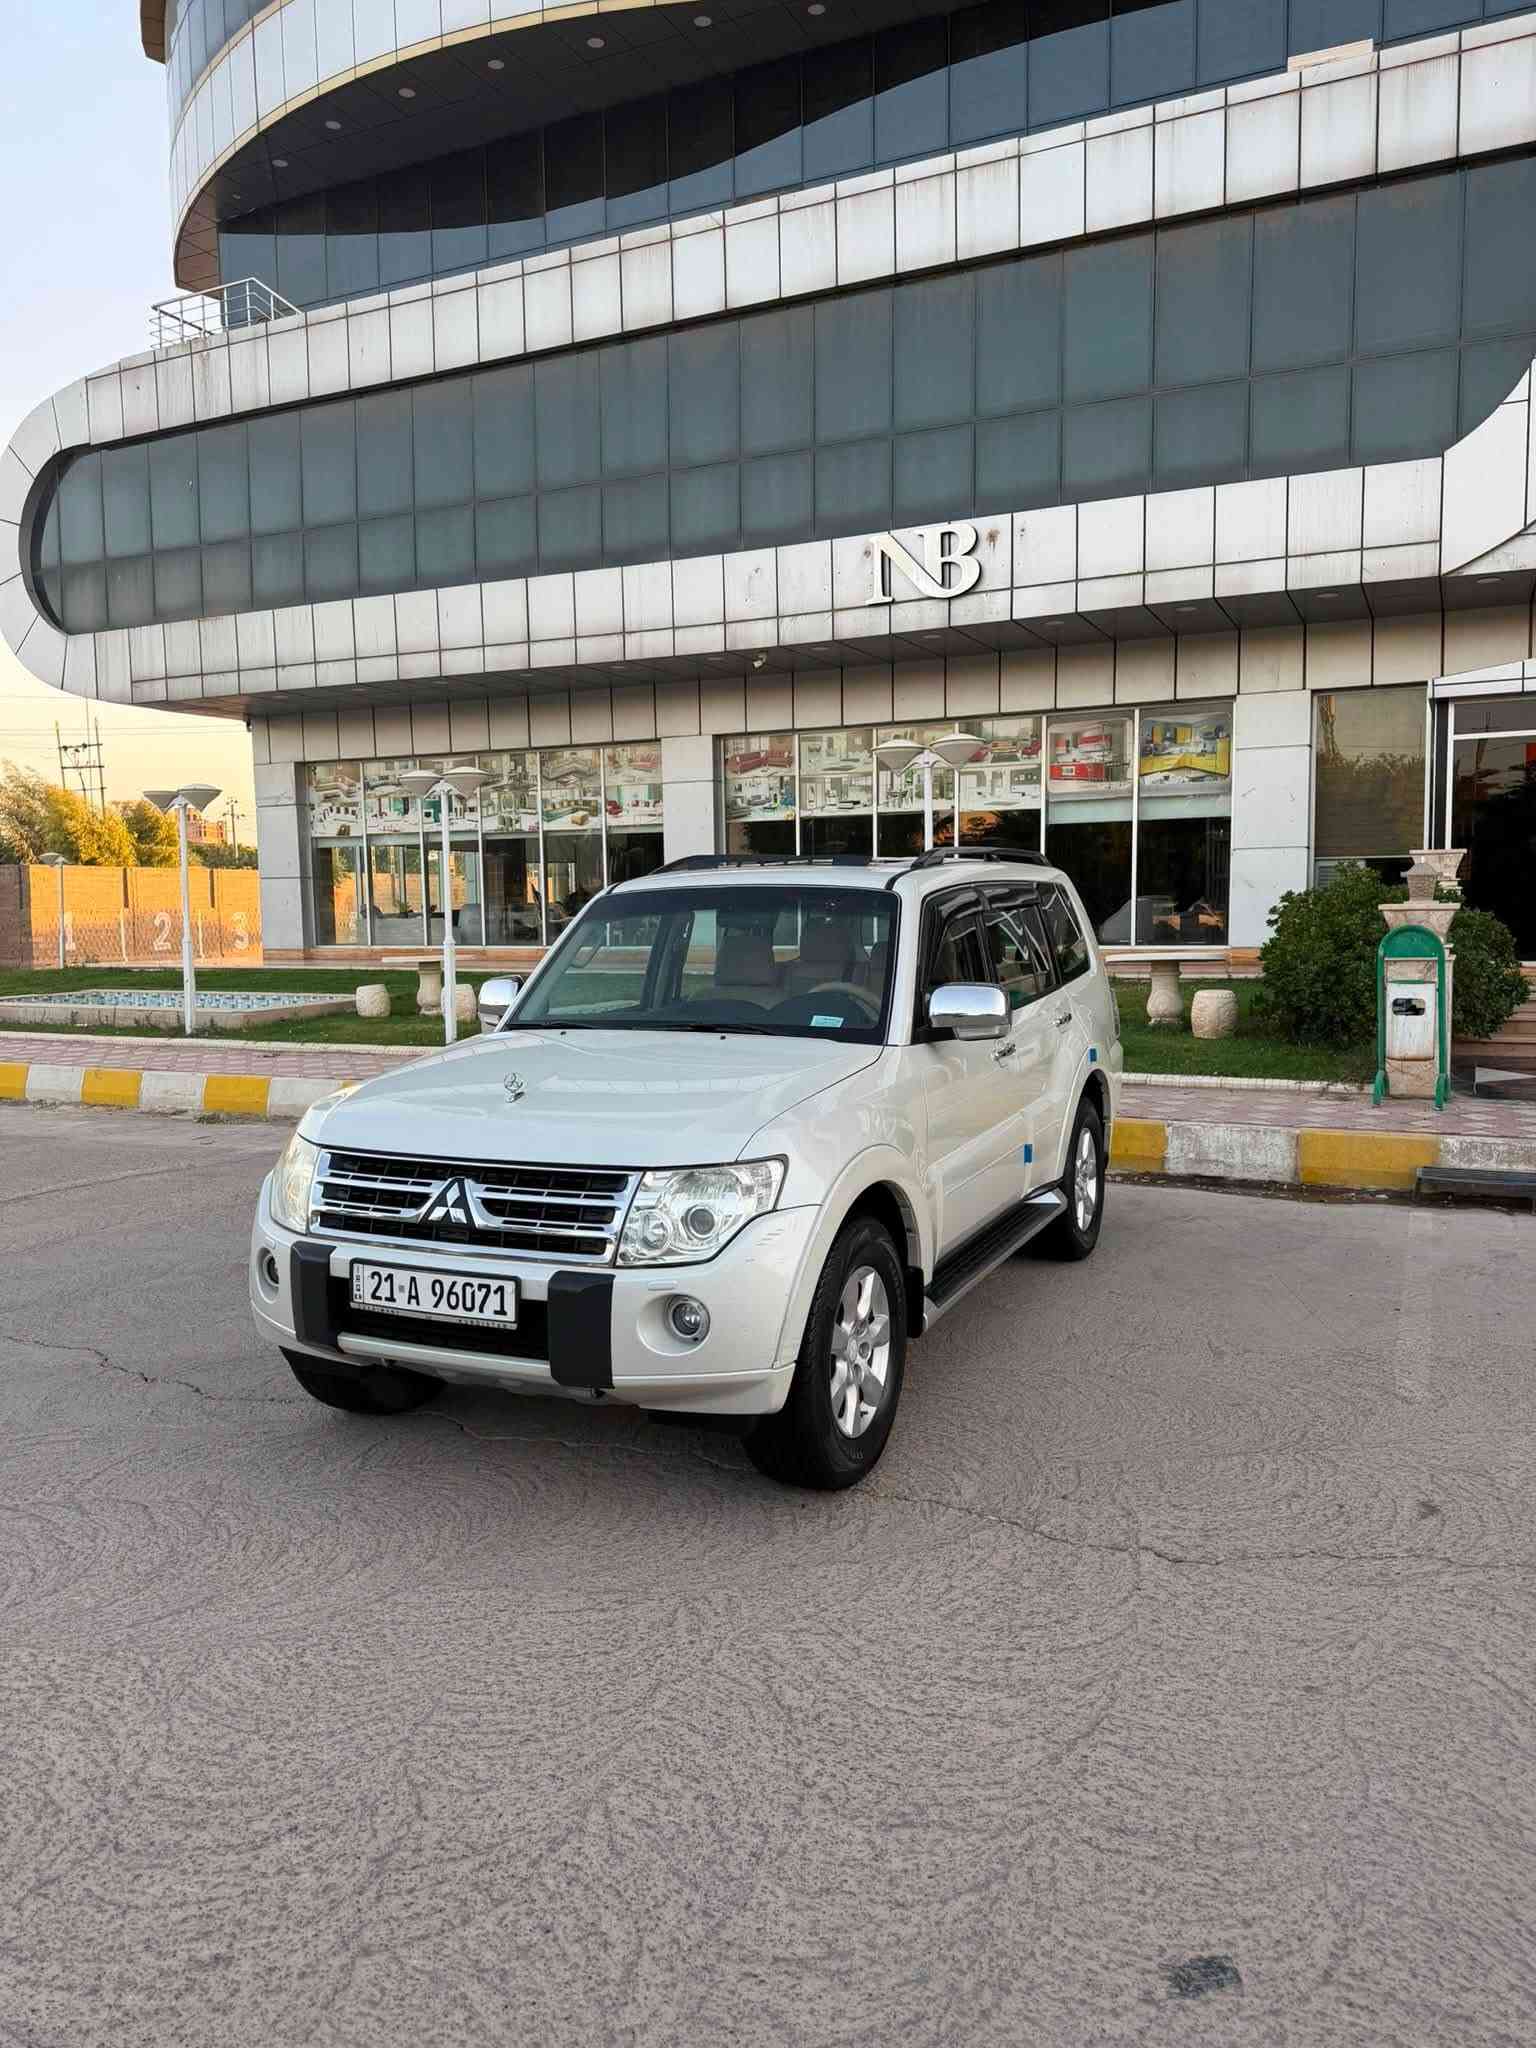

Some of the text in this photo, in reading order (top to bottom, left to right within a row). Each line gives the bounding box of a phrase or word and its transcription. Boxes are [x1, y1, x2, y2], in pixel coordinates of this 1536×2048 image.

[865, 523, 981, 606] NB
[153, 912, 172, 950] 2
[232, 911, 249, 950] 3
[371, 1271, 396, 1302] 21
[407, 1276, 420, 1306] A
[431, 1279, 507, 1316] 96071
